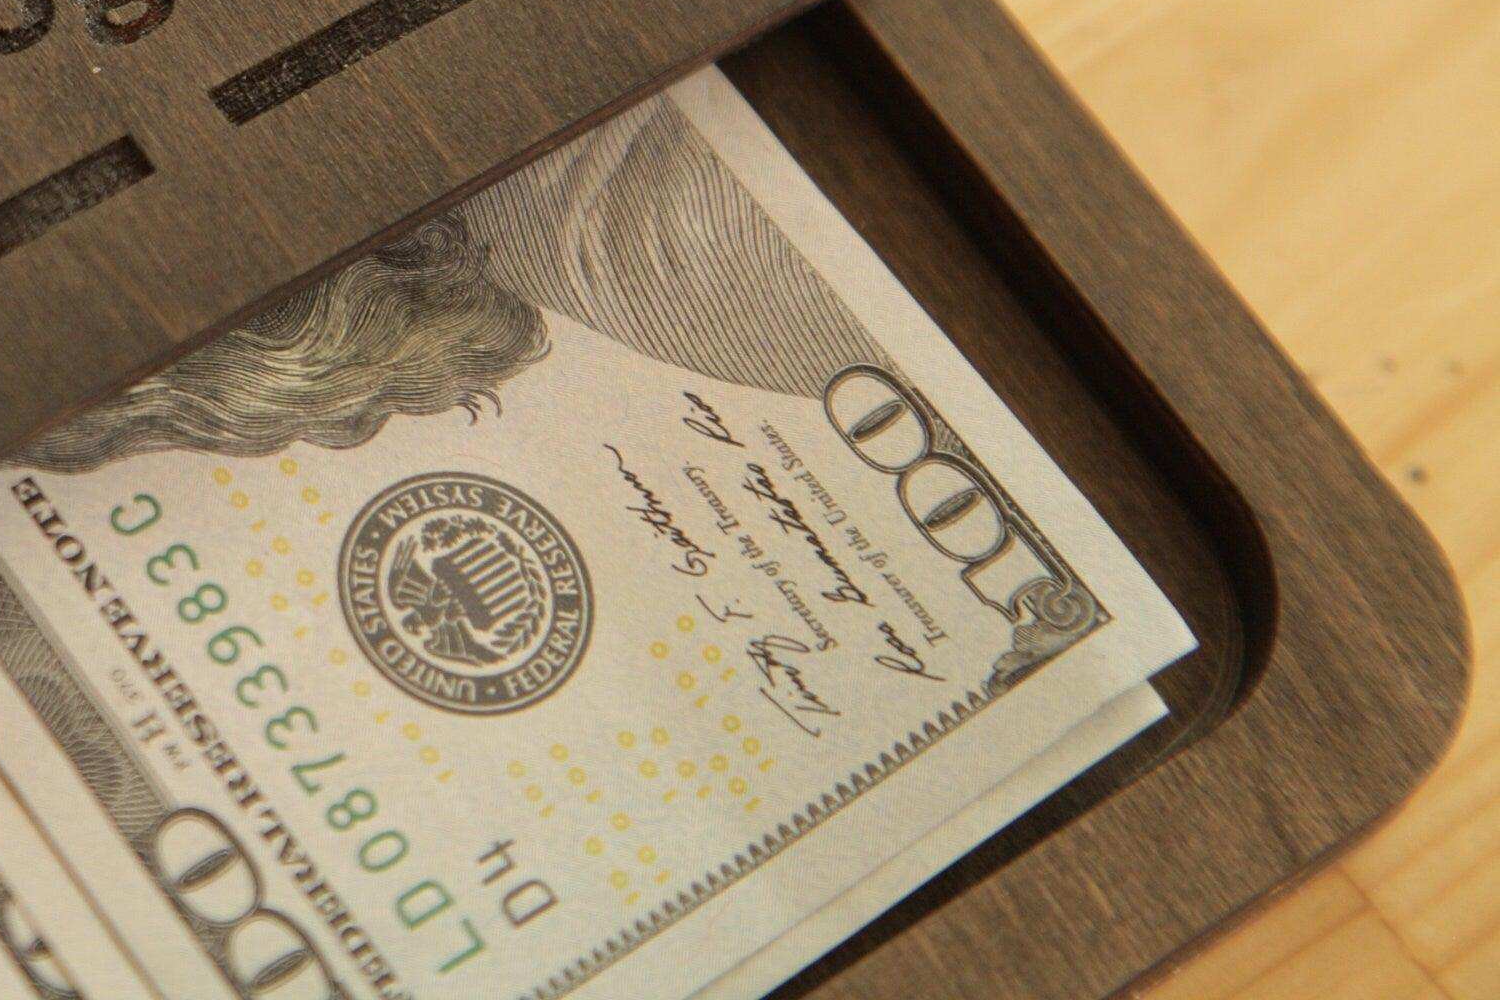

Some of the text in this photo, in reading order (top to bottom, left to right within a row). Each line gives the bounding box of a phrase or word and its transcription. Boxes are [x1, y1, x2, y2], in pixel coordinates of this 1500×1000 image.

[794, 470, 848, 526] United
[824, 363, 1072, 624] 100
[11, 477, 110, 597] NOTE
[737, 534, 764, 560] the
[751, 560, 781, 577] of
[845, 526, 871, 551] the
[859, 551, 889, 569] of
[351, 544, 477, 701] UNITED STATES
[377, 485, 580, 698] FEDERAL RESERVE SYSTEM
[775, 579, 839, 650] Secretary
[881, 572, 950, 647] Treasurer
[100, 597, 263, 810] RESERVE
[477, 838, 560, 928] D4
